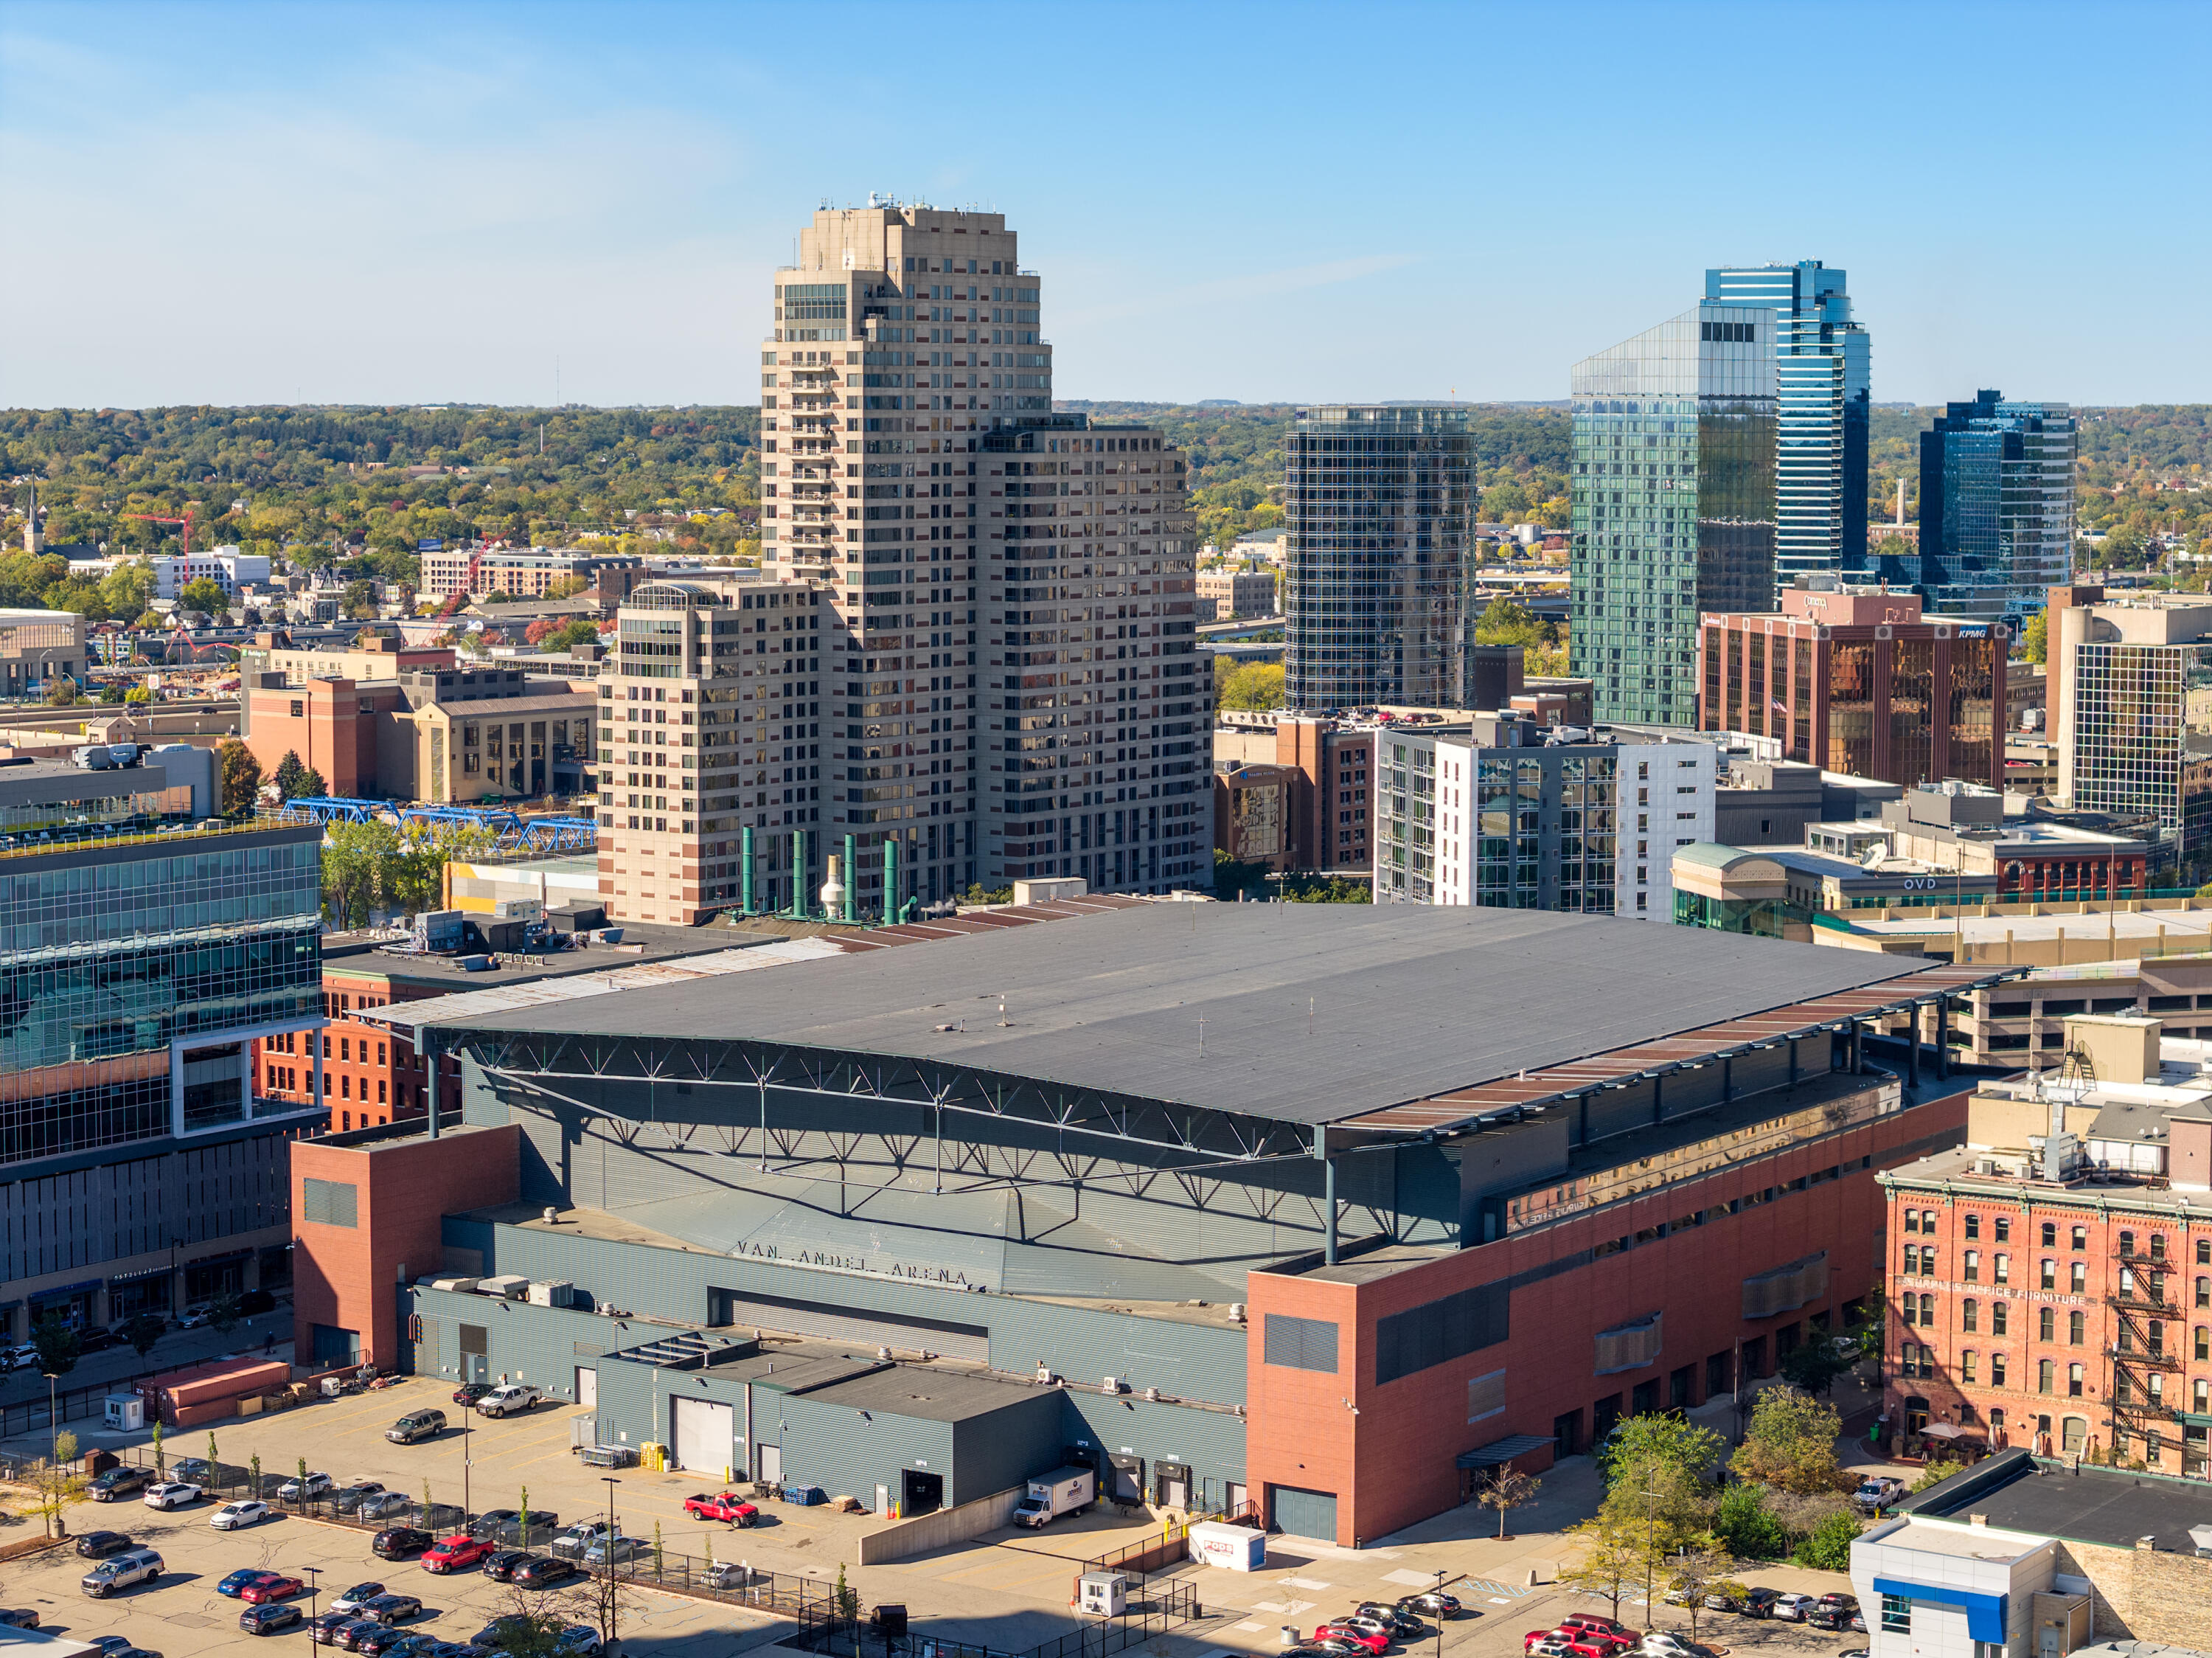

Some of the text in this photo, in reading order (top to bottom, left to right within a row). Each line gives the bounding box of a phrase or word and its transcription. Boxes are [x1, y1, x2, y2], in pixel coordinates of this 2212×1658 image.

[1958, 629, 1986, 639] KPMG
[1904, 878, 1936, 890] OVD
[737, 1241, 967, 1285] VAN ANDEL ARENA
[119, 1268, 151, 1280] STELLAR
[1902, 1277, 2085, 1305] SURPLUS OFFICE FURNITURE
[1204, 1541, 1233, 1553] PODS
